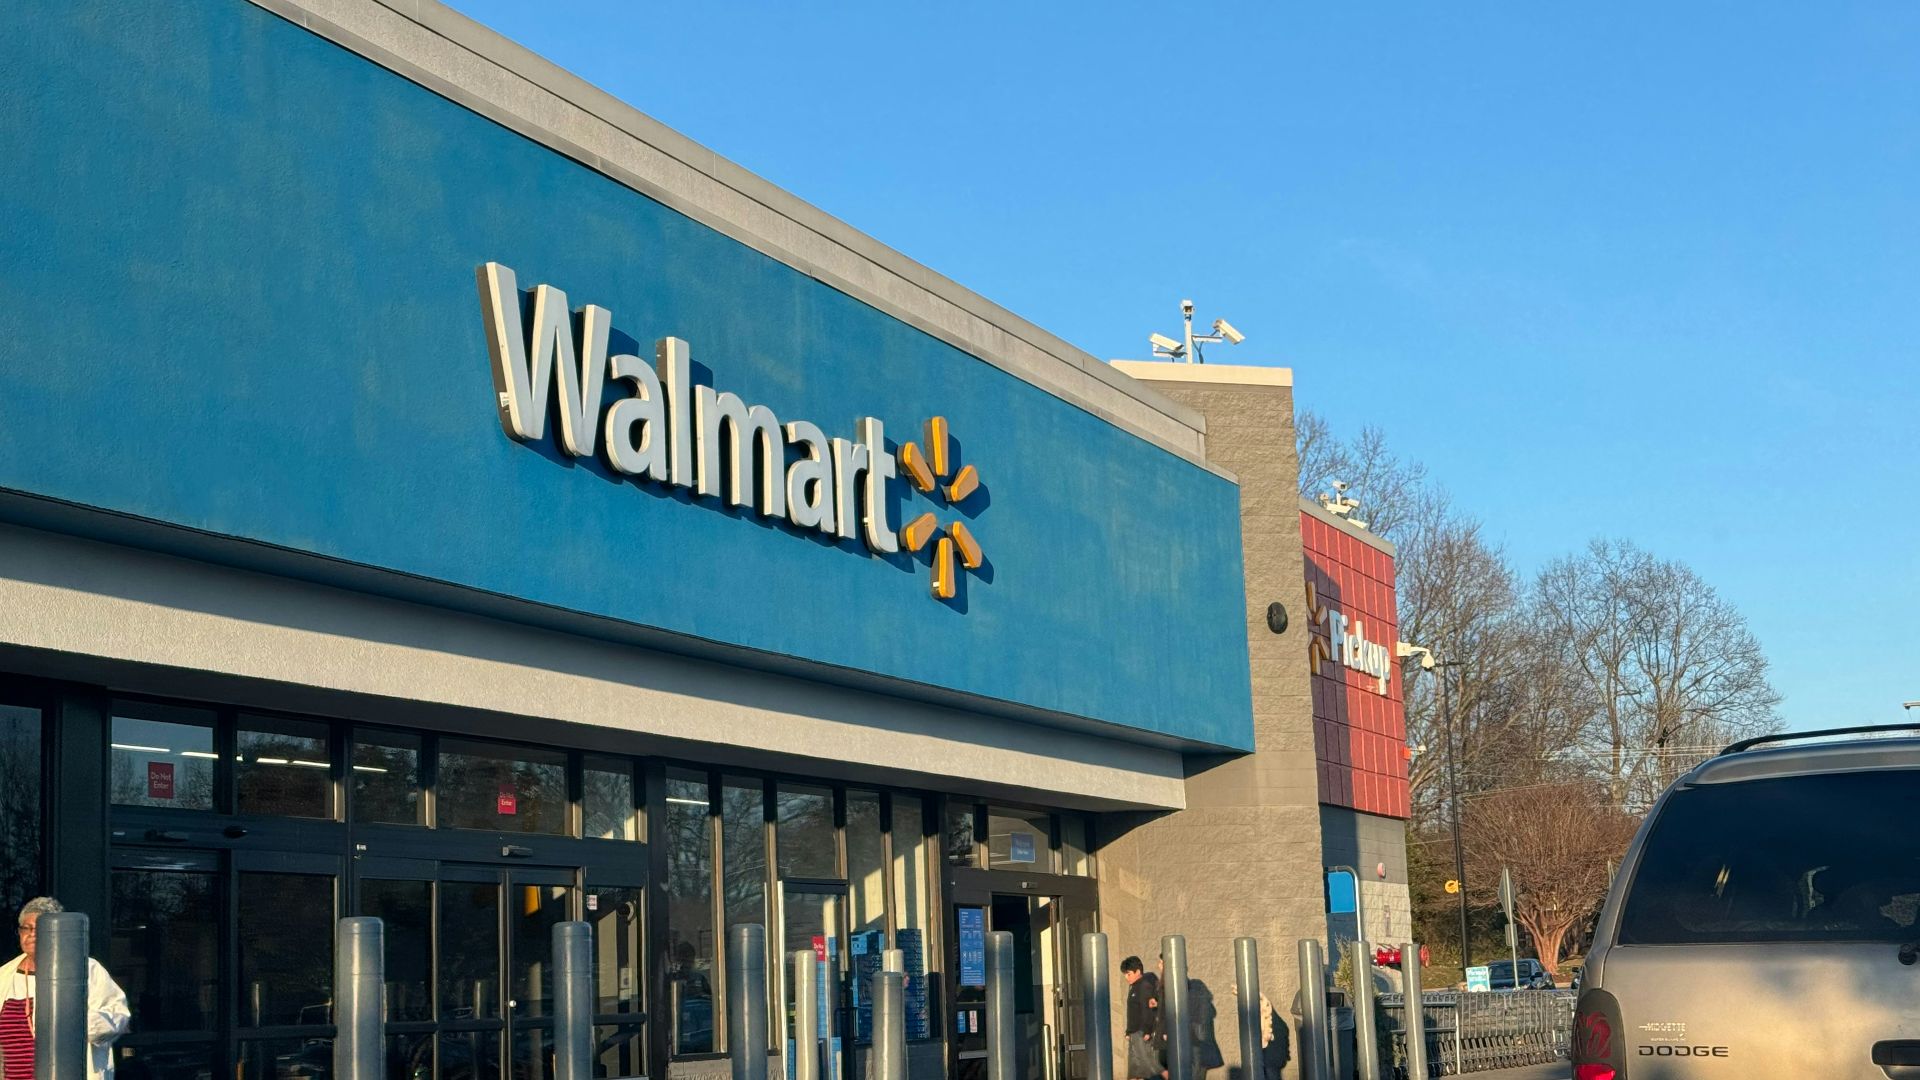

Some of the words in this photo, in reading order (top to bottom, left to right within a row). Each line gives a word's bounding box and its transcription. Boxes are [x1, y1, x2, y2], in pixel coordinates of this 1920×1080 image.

[477, 262, 898, 553] Walmart
[1329, 609, 1390, 695] Pickup
[151, 771, 159, 780] Do
[153, 780, 169, 789] Enter
[1638, 1045, 1729, 1057] DODGE
